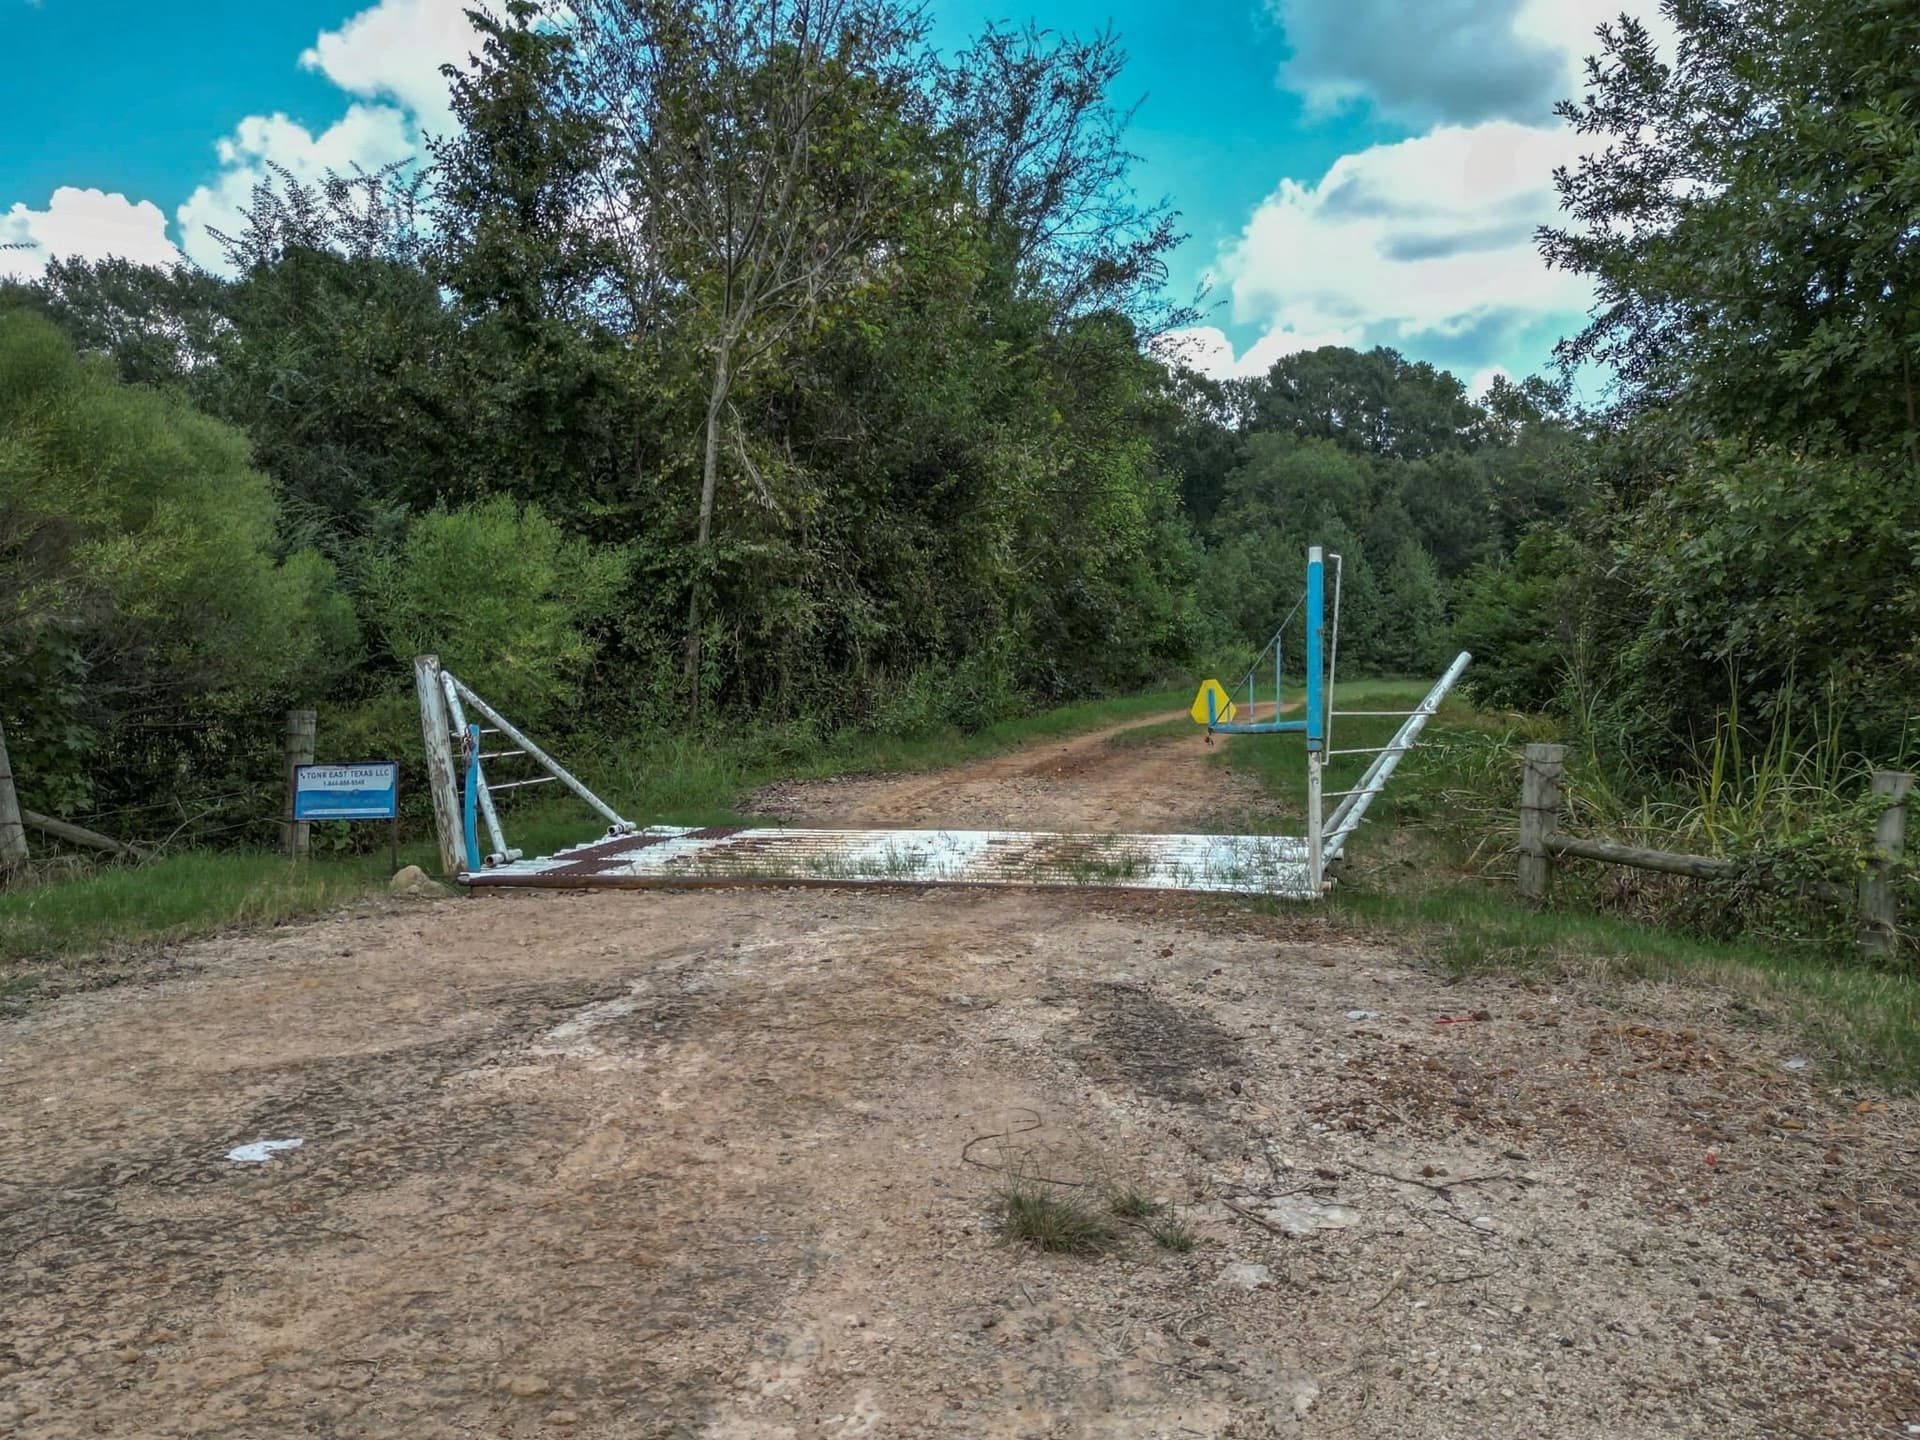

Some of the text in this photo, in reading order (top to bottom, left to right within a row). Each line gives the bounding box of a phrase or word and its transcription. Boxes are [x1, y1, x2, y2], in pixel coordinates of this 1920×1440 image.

[329, 770, 347, 779] EAST
[350, 769, 373, 779] TEXAS
[376, 768, 390, 777] LLC
